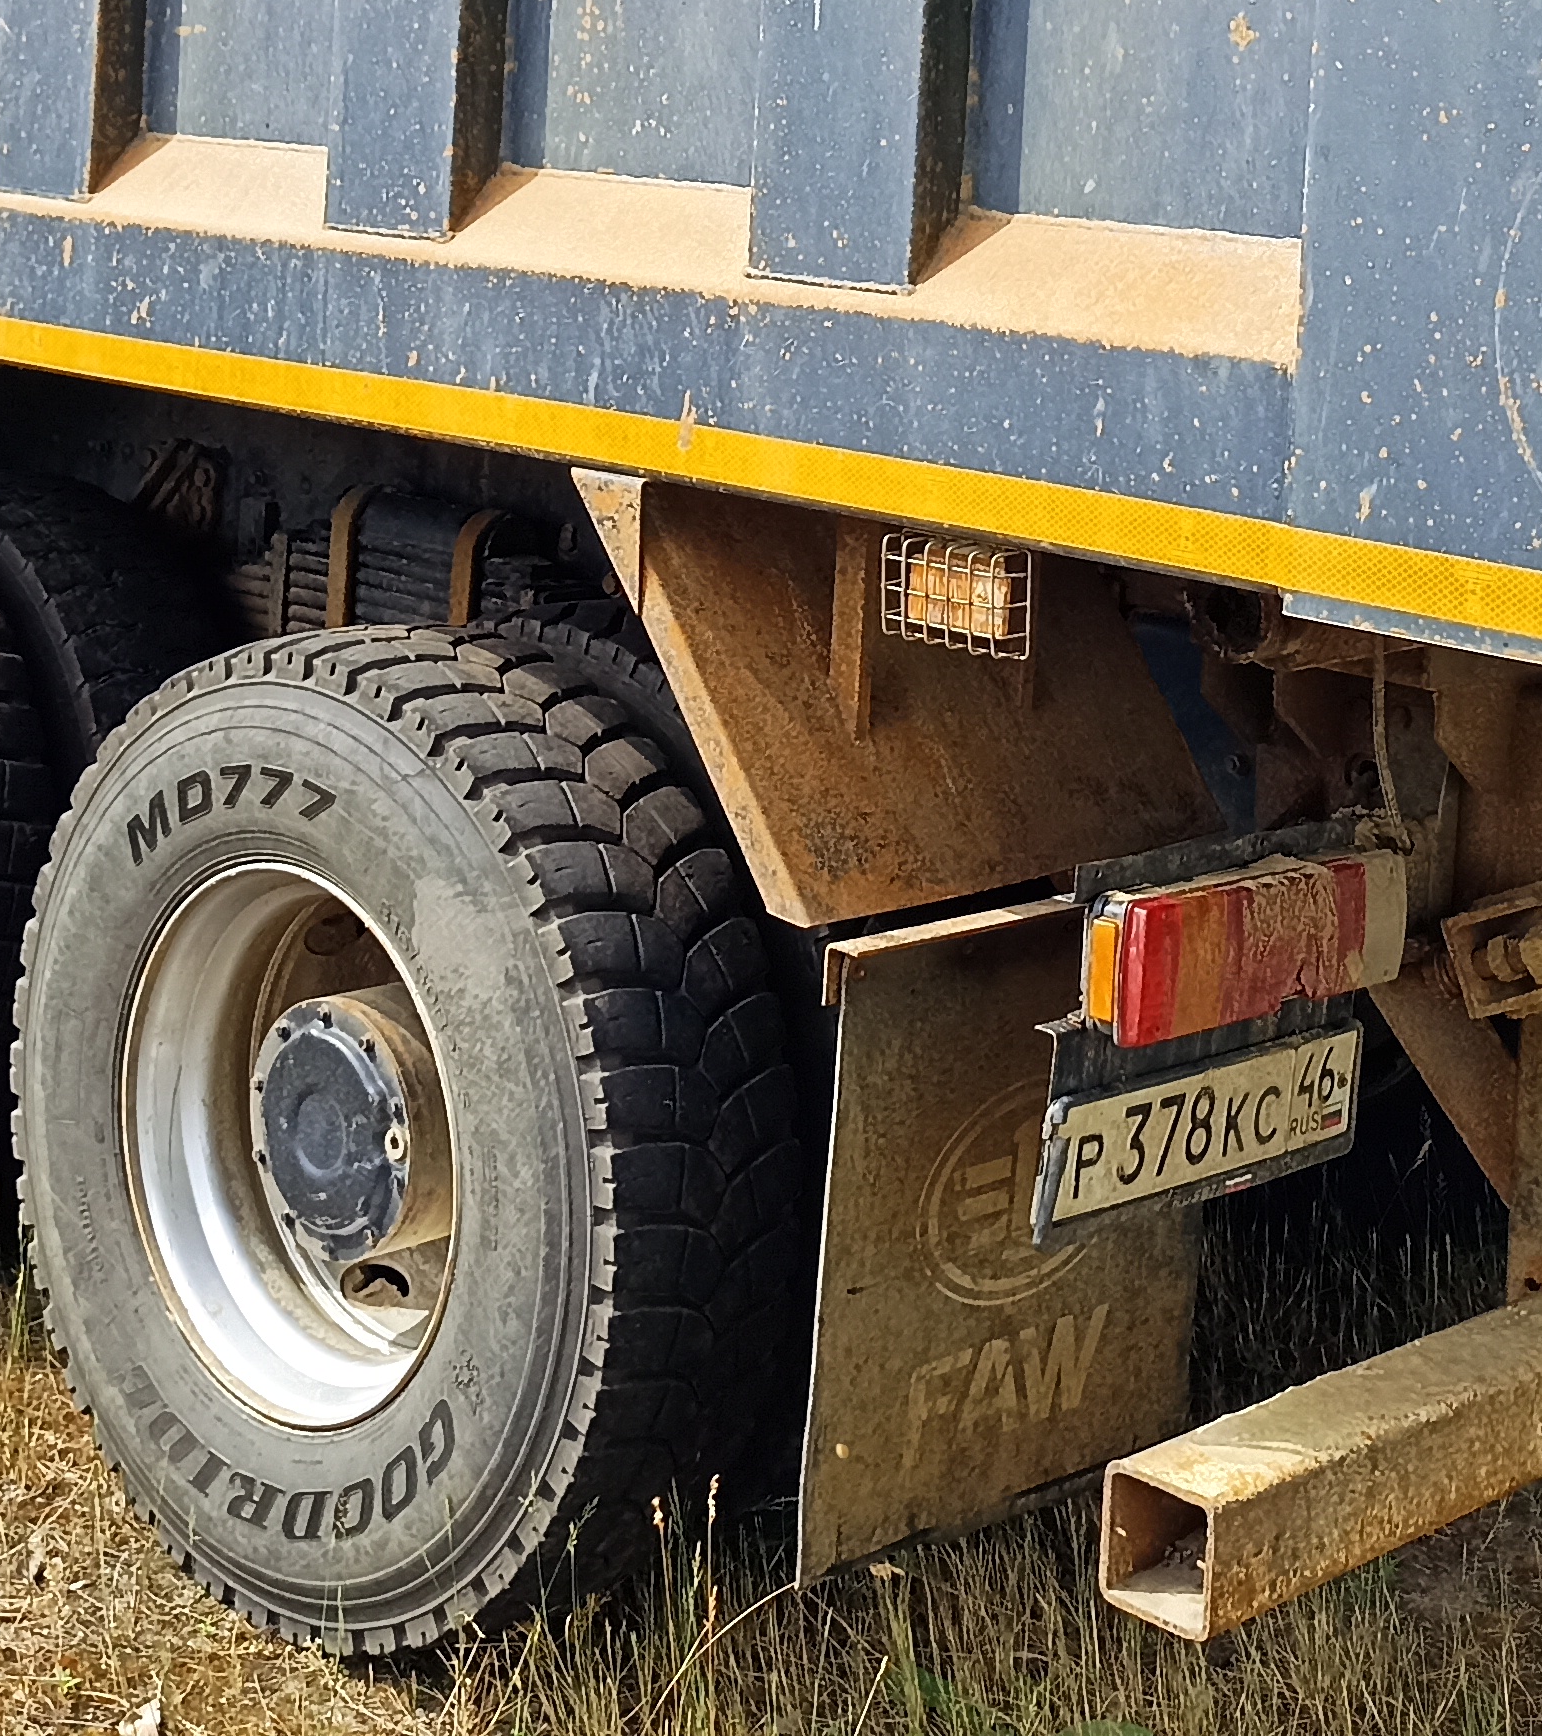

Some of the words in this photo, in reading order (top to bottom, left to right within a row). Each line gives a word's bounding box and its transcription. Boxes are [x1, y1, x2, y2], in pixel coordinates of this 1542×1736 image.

[126, 762, 337, 866] MD777
[1296, 1046, 1335, 1109] 46
[1288, 1111, 1320, 1137] RUS
[902, 1302, 1109, 1478] FAW
